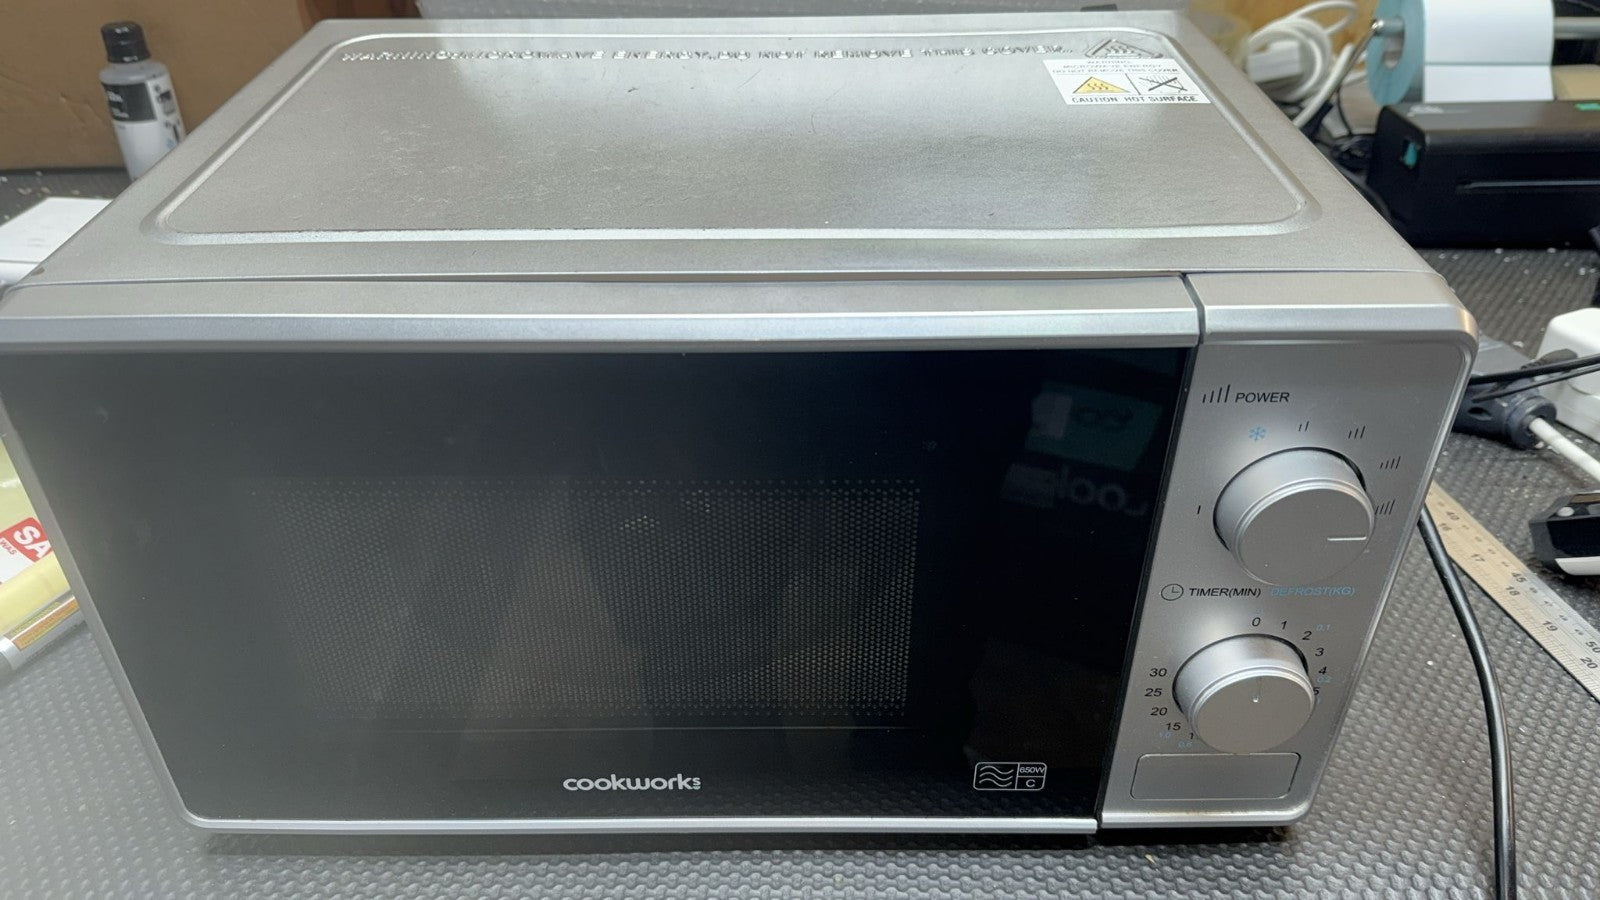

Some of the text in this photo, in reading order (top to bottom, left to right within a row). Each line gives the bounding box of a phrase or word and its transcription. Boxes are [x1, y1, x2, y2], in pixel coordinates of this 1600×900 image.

[1072, 95, 1118, 103] CAUTION
[1124, 95, 1148, 103] HOT
[1235, 392, 1290, 403] POWER
[0, 540, 17, 555] WAS
[1189, 586, 1356, 598] TIMER(MIN) DEFROST(KG)
[1471, 553, 1485, 562] 17
[1505, 586, 1520, 596] 18
[1542, 620, 1558, 631] 19
[1580, 657, 1598, 669] 20
[1512, 572, 1527, 583] 45
[1585, 641, 1600, 653] 50
[1252, 617, 1261, 627] 0
[1281, 621, 1288, 630] 1
[1302, 631, 1312, 641] 2
[1315, 648, 1324, 657] 3
[1149, 668, 1167, 677] 30
[1318, 666, 1327, 675] 4
[1145, 688, 1162, 697] 25
[1313, 687, 1320, 696] 5
[1151, 707, 1168, 716] 20
[1166, 722, 1181, 731] 15
[1020, 766, 1045, 774] 650W
[563, 773, 701, 791] cookworks
[1025, 779, 1036, 788] C
